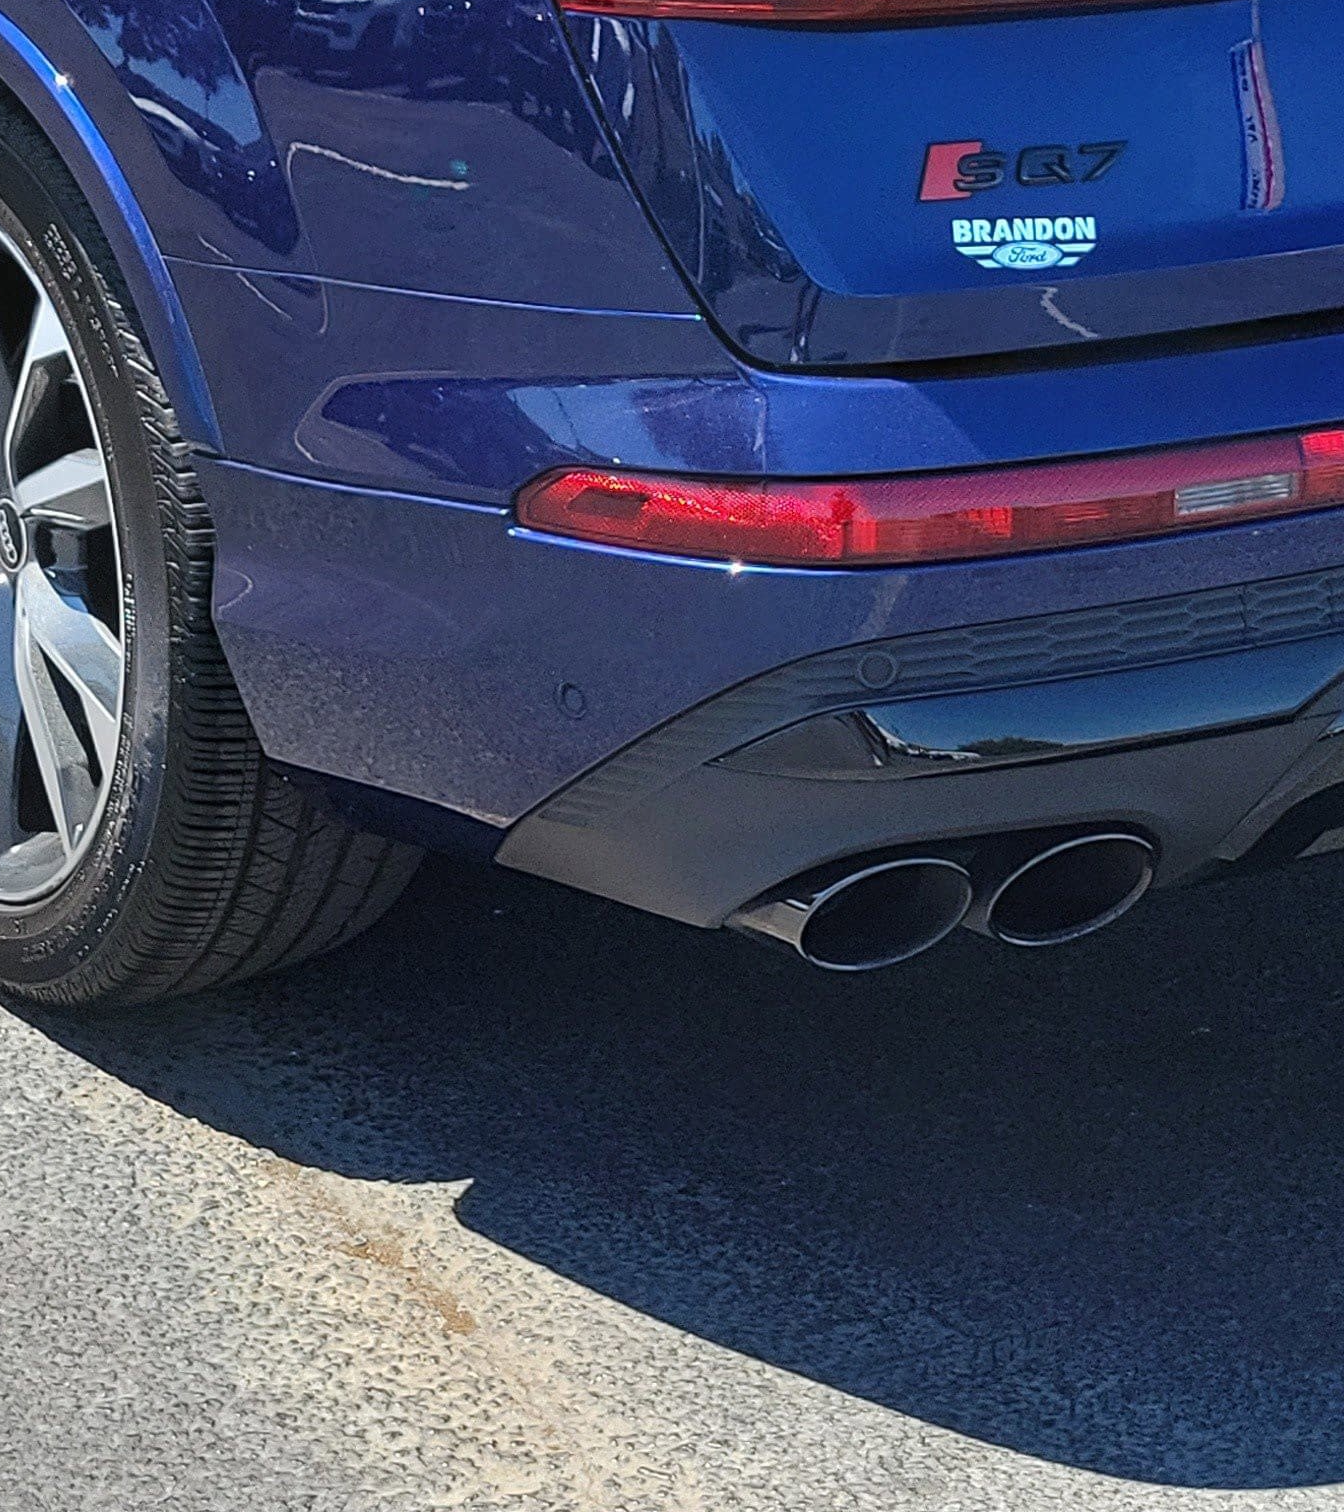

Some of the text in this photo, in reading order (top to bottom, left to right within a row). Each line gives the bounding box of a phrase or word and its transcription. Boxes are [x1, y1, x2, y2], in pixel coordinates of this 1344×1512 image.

[950, 139, 1129, 192] SQ7
[951, 216, 1096, 243] BRANDON
[1007, 247, 1048, 264] Ford
